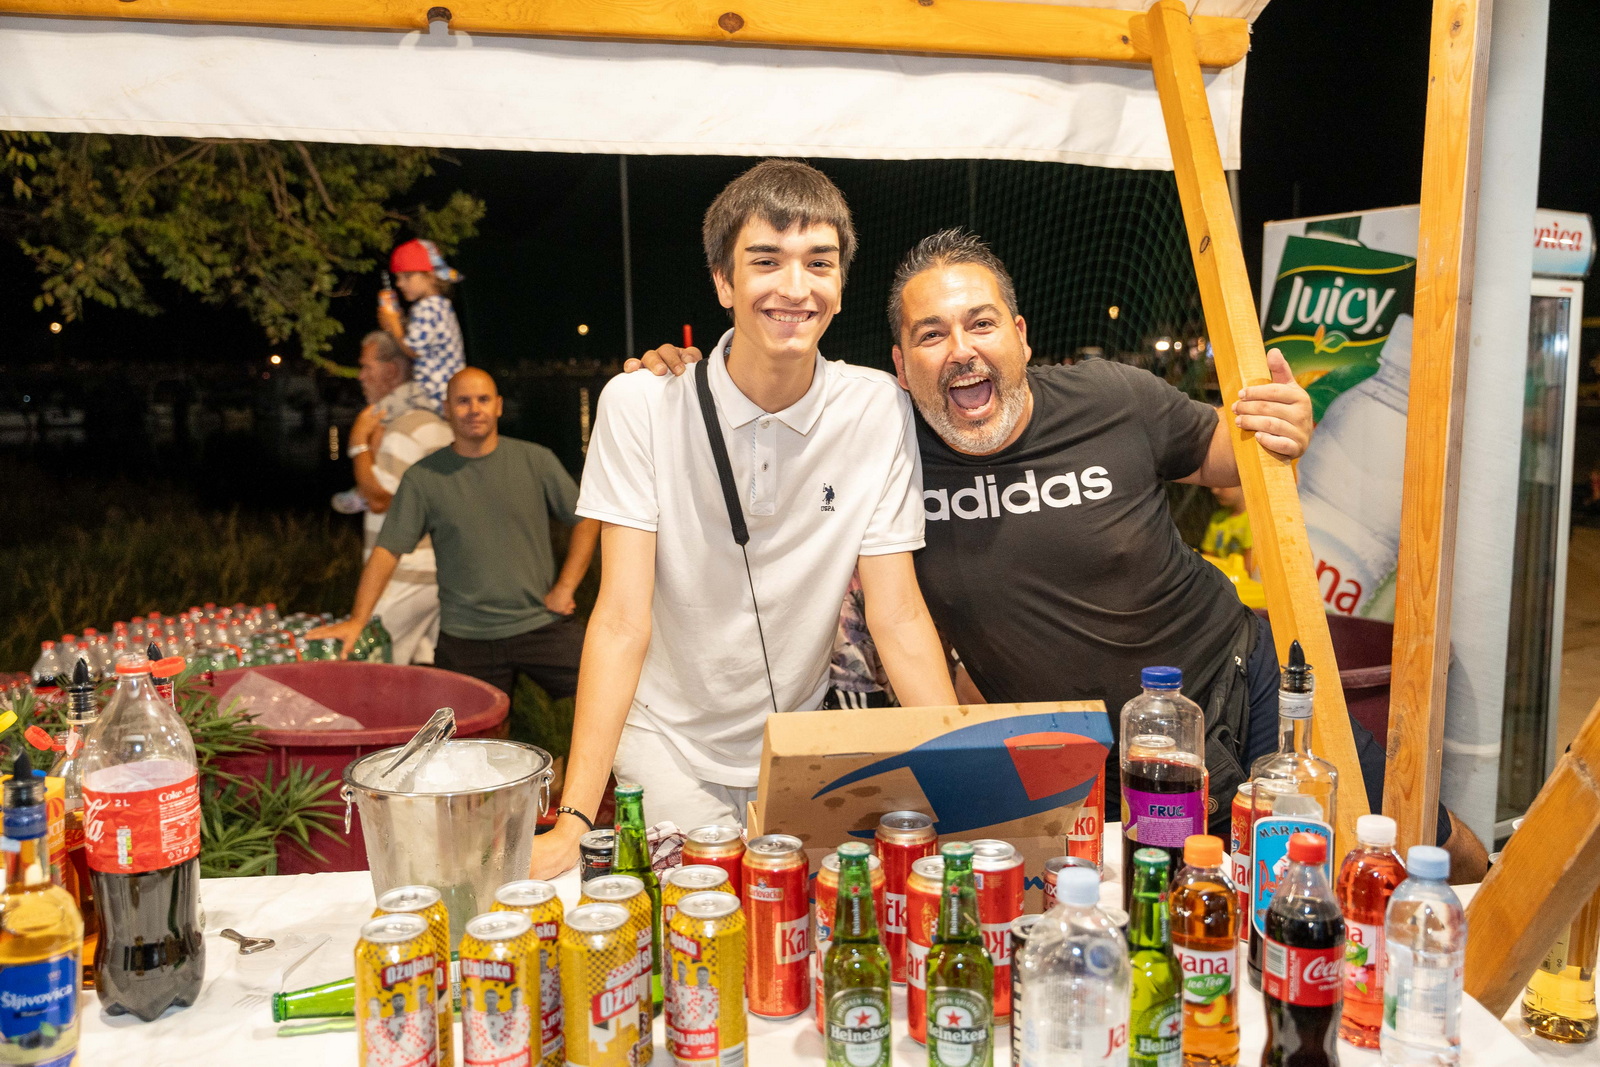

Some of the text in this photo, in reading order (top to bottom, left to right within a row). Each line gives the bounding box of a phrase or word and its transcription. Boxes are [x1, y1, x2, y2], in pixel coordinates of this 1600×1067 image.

[1534, 222, 1582, 252] nica
[1271, 275, 1397, 335] Juicy
[923, 465, 1113, 521] adidas
